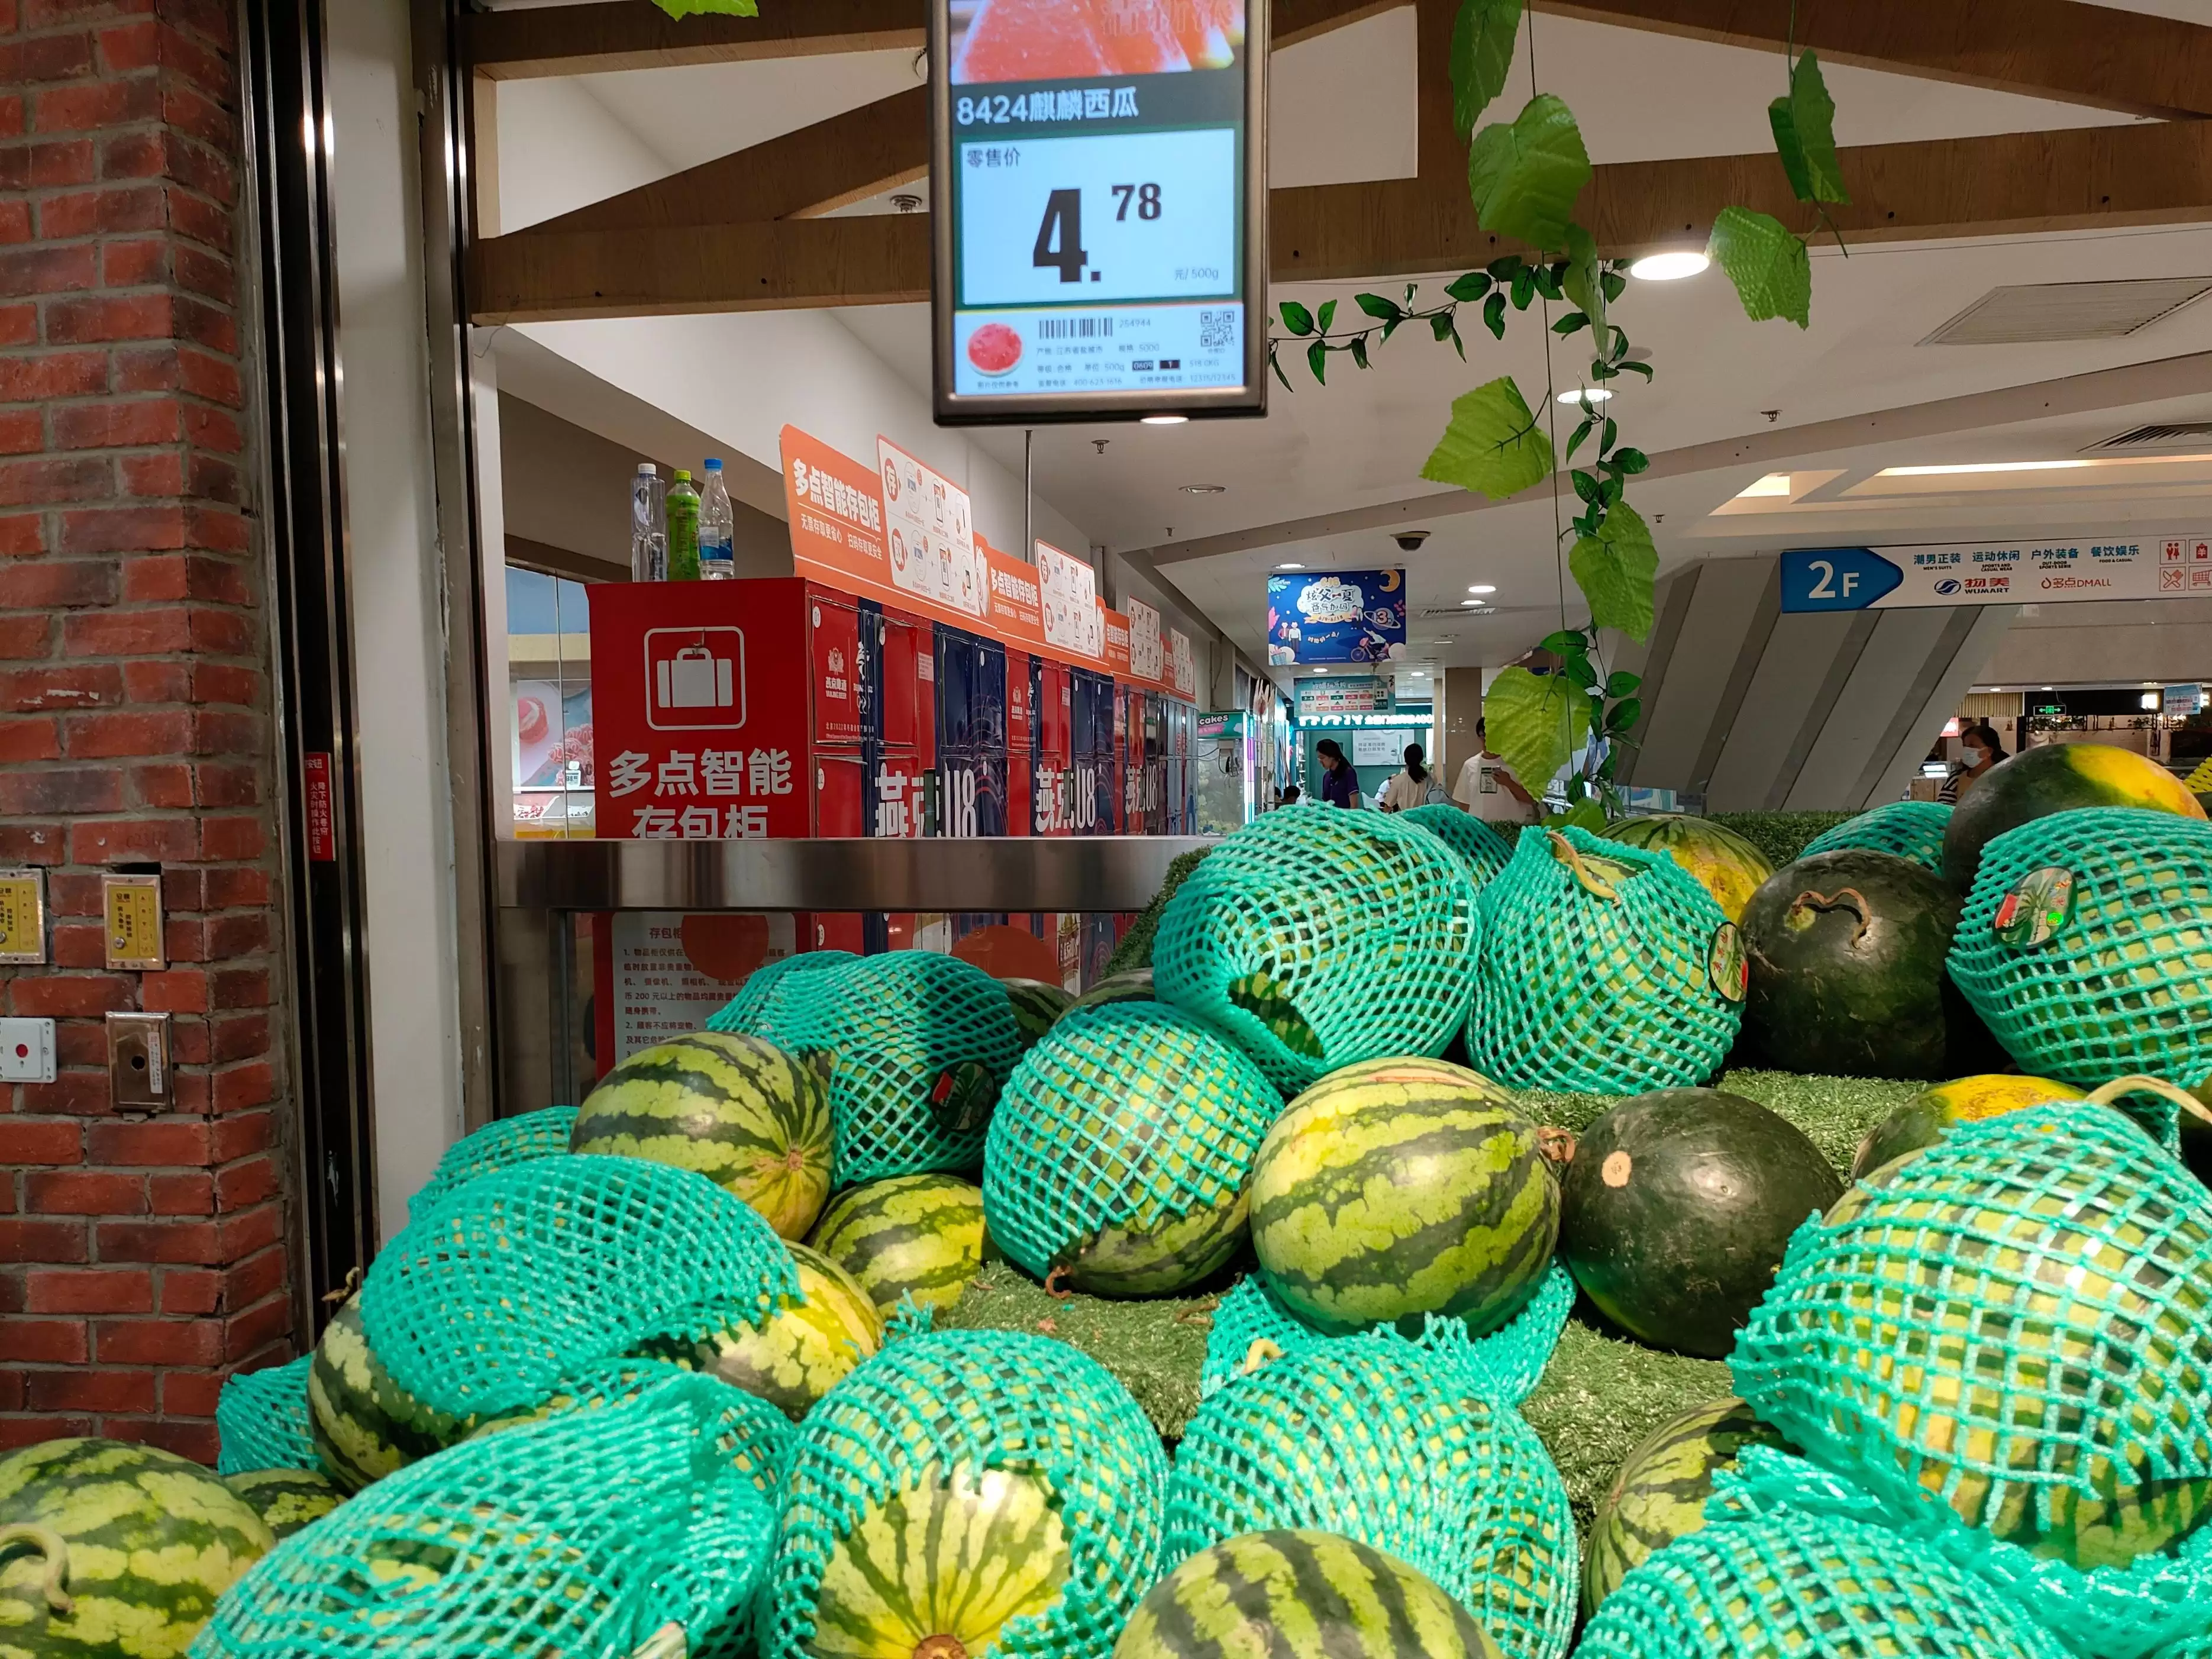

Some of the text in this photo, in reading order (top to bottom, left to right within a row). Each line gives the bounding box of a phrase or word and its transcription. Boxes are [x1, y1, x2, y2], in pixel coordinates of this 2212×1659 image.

[957, 86, 1139, 125] 8424麒麟西瓜
[967, 147, 1021, 168] 零售价
[1111, 183, 1162, 221] 78
[1191, 267, 1219, 280] 500g
[1119, 319, 1151, 328] 254944
[1133, 362, 1154, 370] 0609
[886, 465, 897, 497] 存
[793, 457, 881, 533] 多点智能存包柜
[800, 513, 883, 561] 无票存取更省心 扫码存取更安全
[1972, 550, 2020, 562] 运动休闲
[2030, 547, 2079, 560] 户外装备
[2090, 544, 2140, 557] 餐饮娱乐
[1913, 553, 1961, 566] 潮男正装
[1807, 560, 1860, 599] 2F
[1964, 577, 2010, 588] 物美
[990, 566, 1039, 608] 多点智能存包柜
[1306, 588, 1354, 602] 炫父一夏
[1312, 602, 1348, 612] 爸气加码
[1199, 715, 1229, 725] cakes
[608, 747, 793, 798] 多点智能
[317, 781, 329, 836] 降下防火卷帘
[310, 782, 322, 854] 火灾时操作此按钮
[631, 803, 768, 838] 存包柜
[623, 963, 694, 972] 临时放置非贵重物
[625, 1021, 697, 1030] 2. 顾客不应将宠物、
